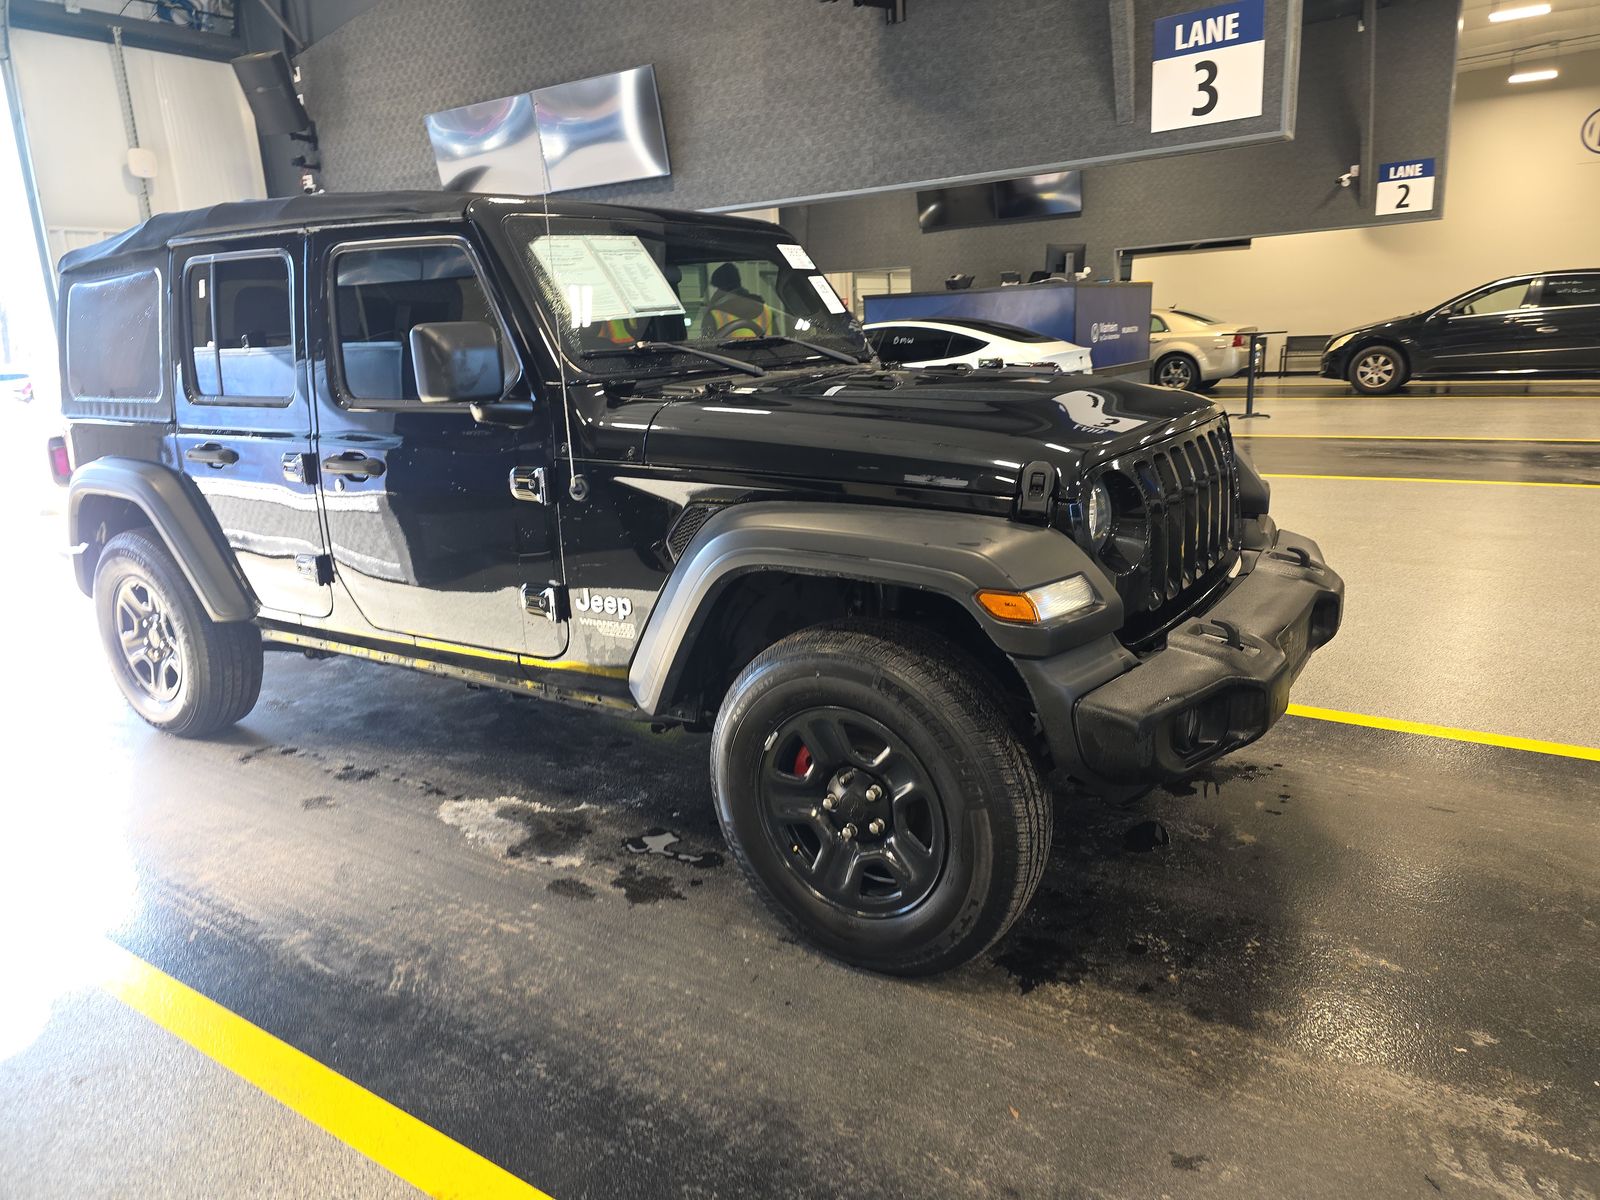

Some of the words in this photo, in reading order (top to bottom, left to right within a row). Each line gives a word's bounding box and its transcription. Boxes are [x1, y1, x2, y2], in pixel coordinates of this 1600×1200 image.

[1175, 12, 1240, 51] LANE
[1191, 60, 1218, 116] 3
[1389, 163, 1423, 179] LANE
[1396, 184, 1410, 208] 2
[575, 587, 633, 620] Jeep
